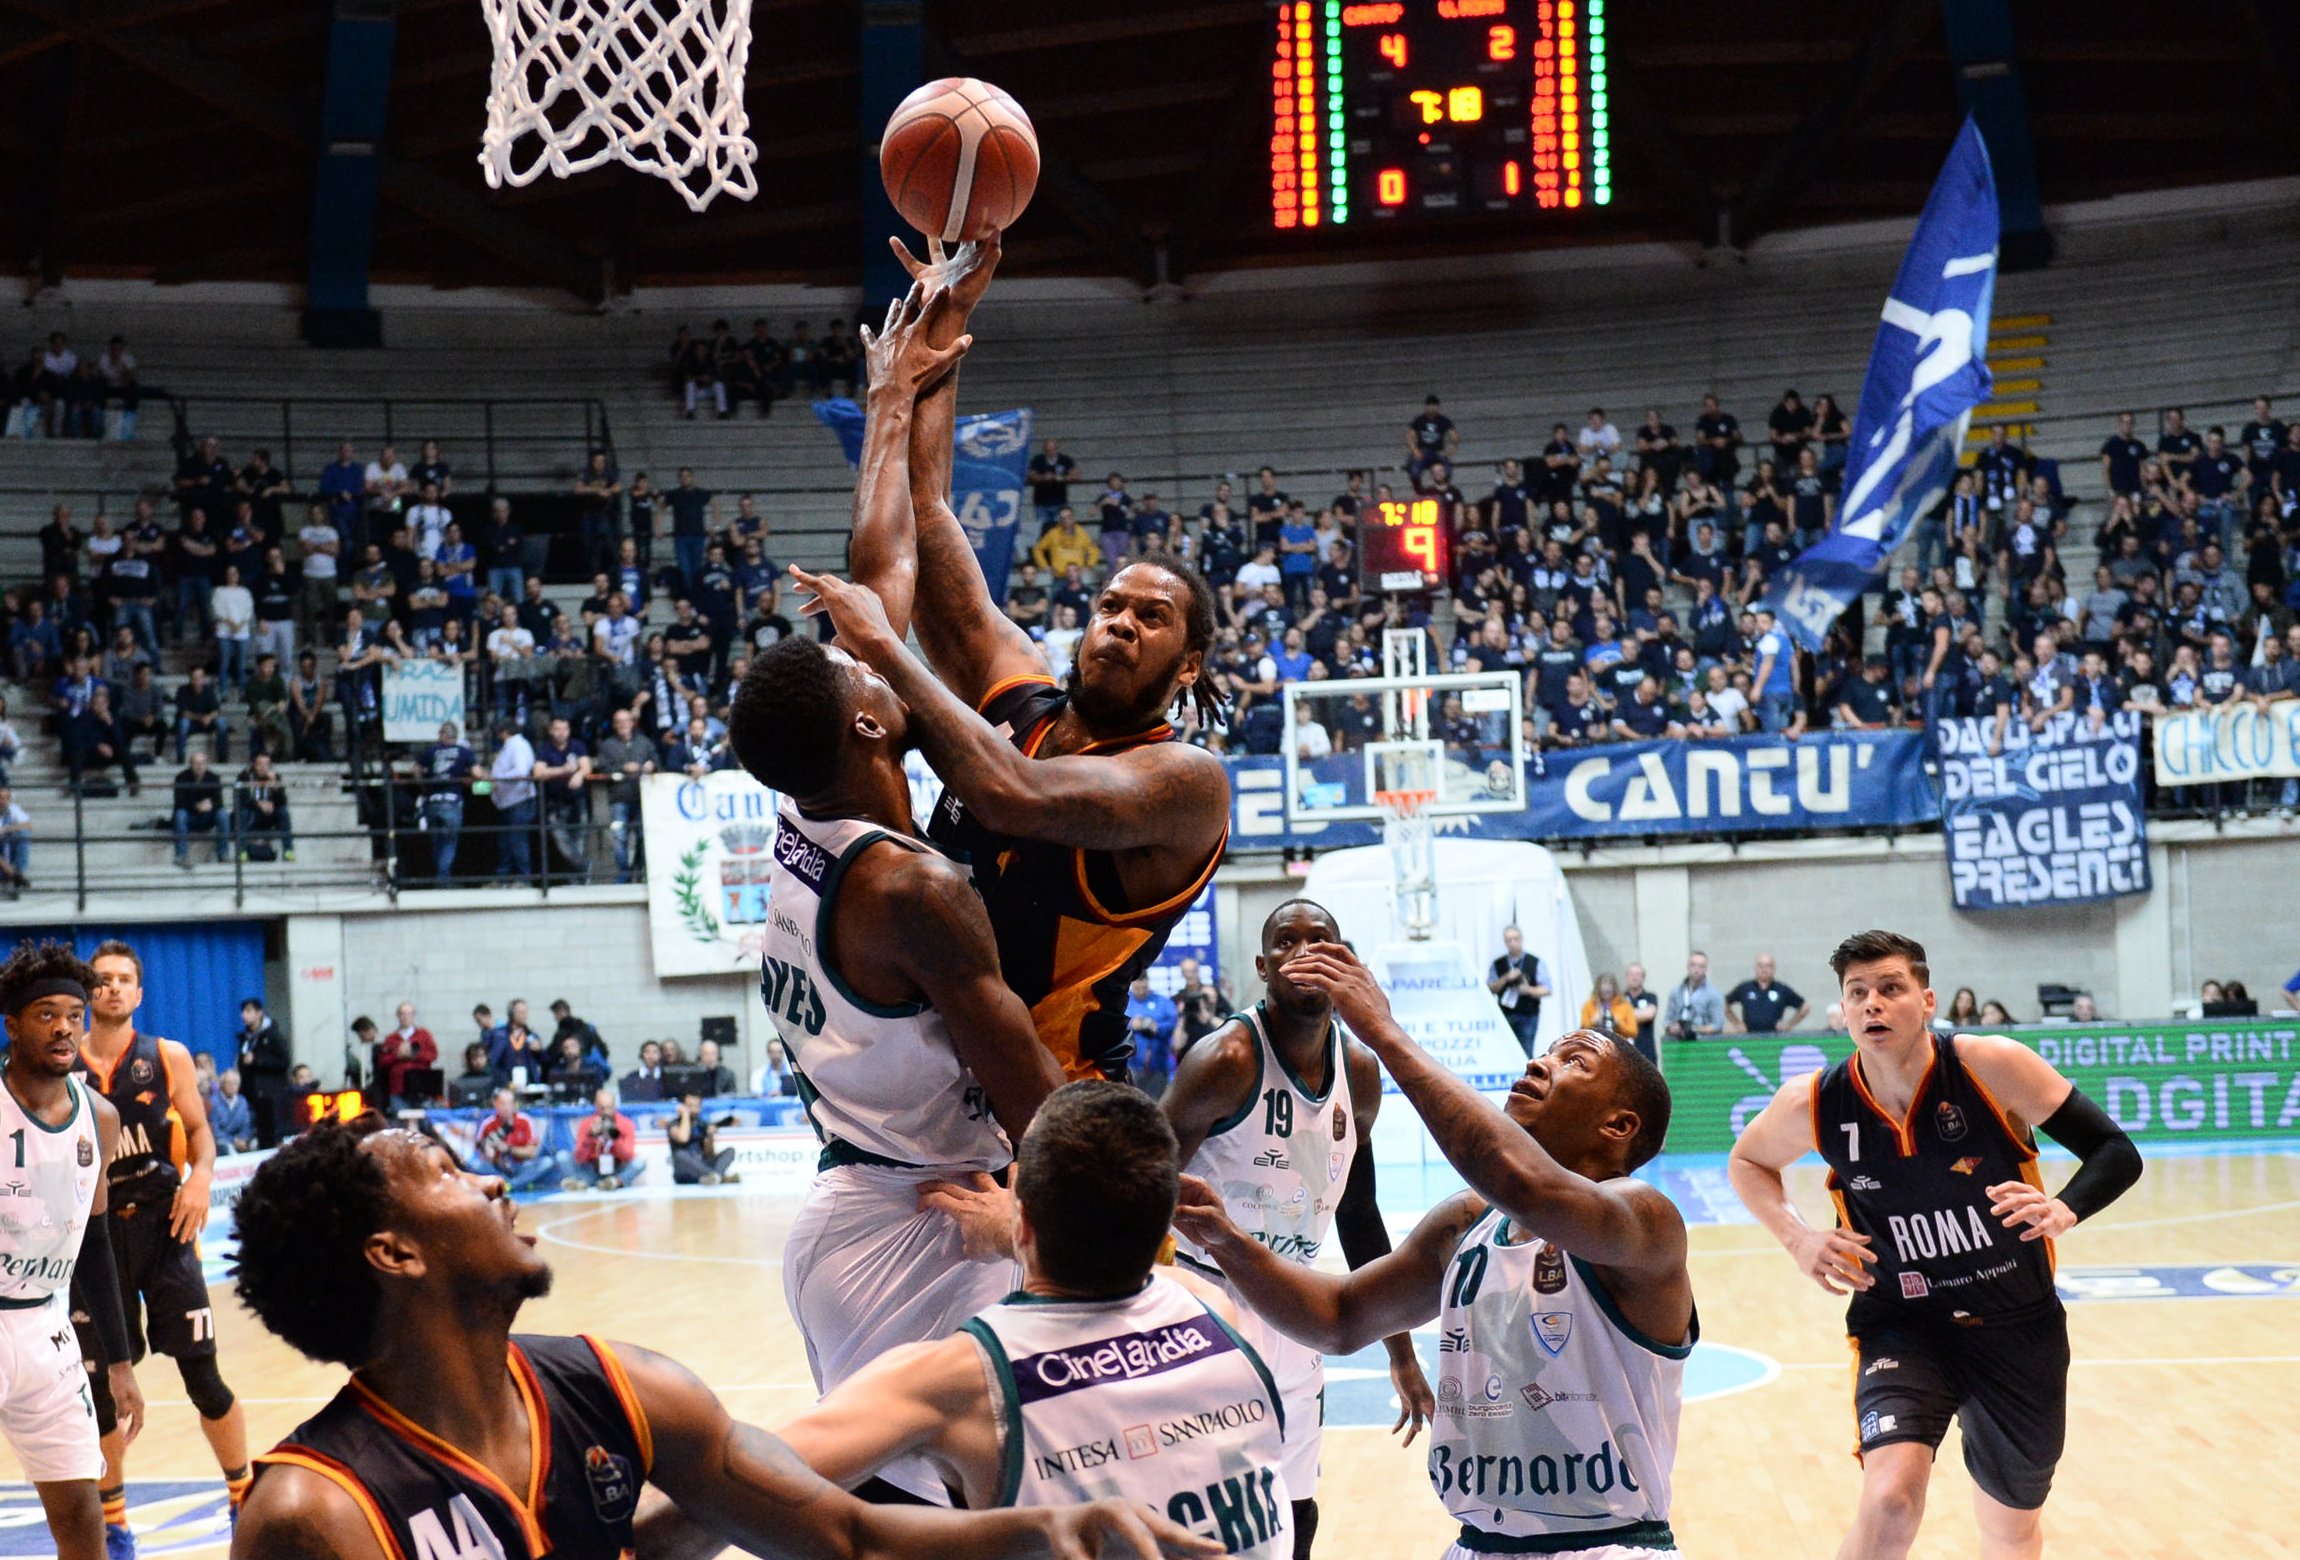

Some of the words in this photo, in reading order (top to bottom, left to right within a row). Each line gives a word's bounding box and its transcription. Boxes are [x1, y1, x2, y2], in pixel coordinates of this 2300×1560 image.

[1380, 34, 1406, 67] 4
[1404, 527, 1435, 571] 9
[1564, 743, 1873, 822] CANTU'
[1944, 756, 2017, 800] DEL
[2025, 742, 2138, 792] CIELO
[1952, 800, 2137, 861] EAGLES
[1952, 843, 2145, 906] PRESENTI
[2038, 1034, 2176, 1067] DIGITAL
[2186, 1031, 2296, 1063] PRINT
[1263, 1087, 1293, 1138] 19
[9, 1128, 25, 1168] 1
[1840, 1122, 1860, 1162] 7
[1888, 1205, 1994, 1263] ROMA
[1450, 1242, 1488, 1308] 10
[1539, 1269, 1564, 1282] LBA
[1036, 1325, 1213, 1386] CineLandia
[1034, 1438, 1121, 1480] INTESA
[1158, 1399, 1265, 1447] SANPAOLO
